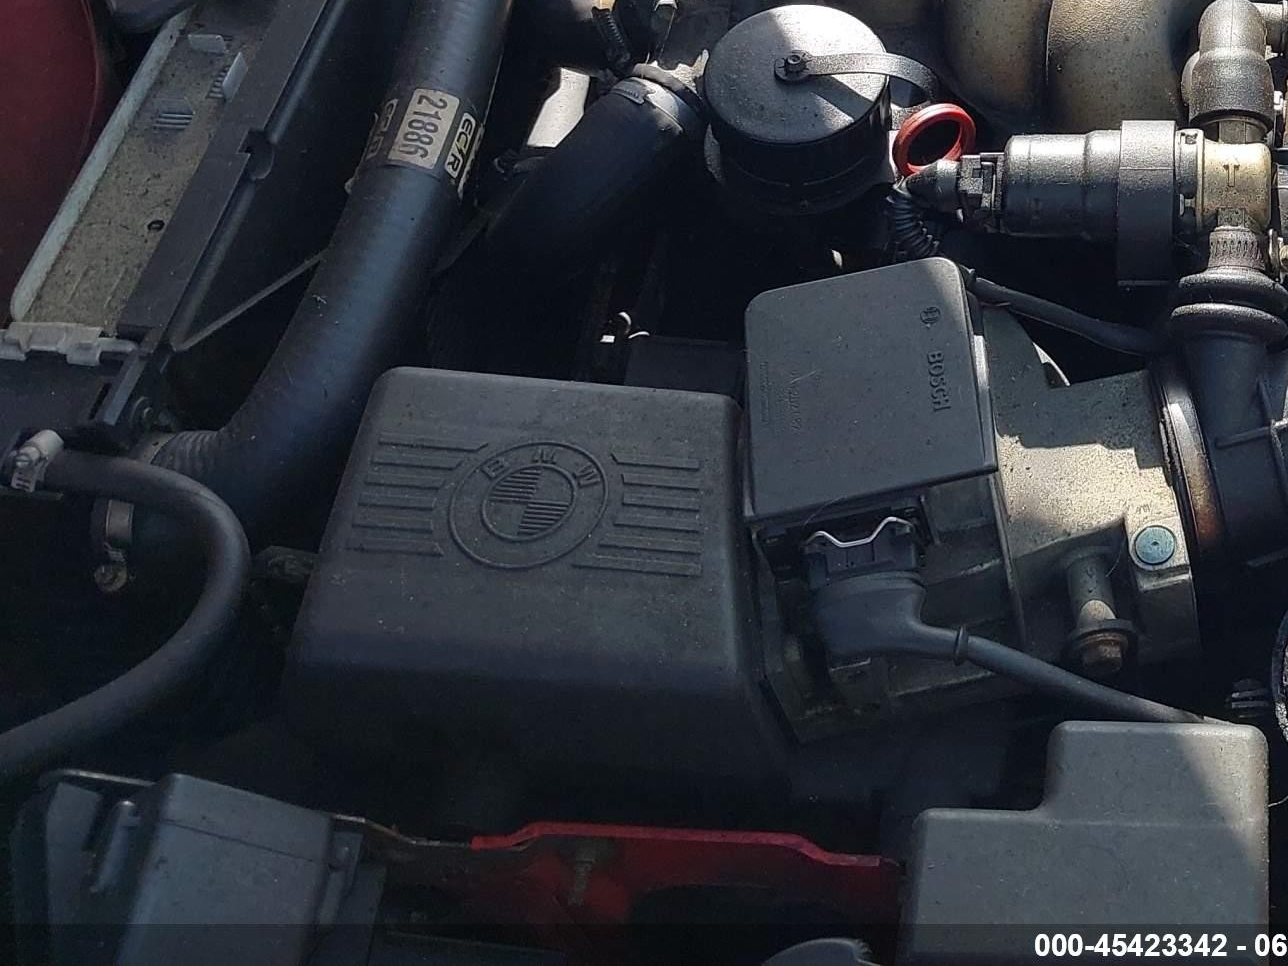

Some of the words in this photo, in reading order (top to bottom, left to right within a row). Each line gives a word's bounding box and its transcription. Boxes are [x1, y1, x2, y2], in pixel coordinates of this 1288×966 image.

[398, 94, 448, 159] 21886
[926, 349, 952, 413] BOSCH
[480, 448, 602, 487] BMW
